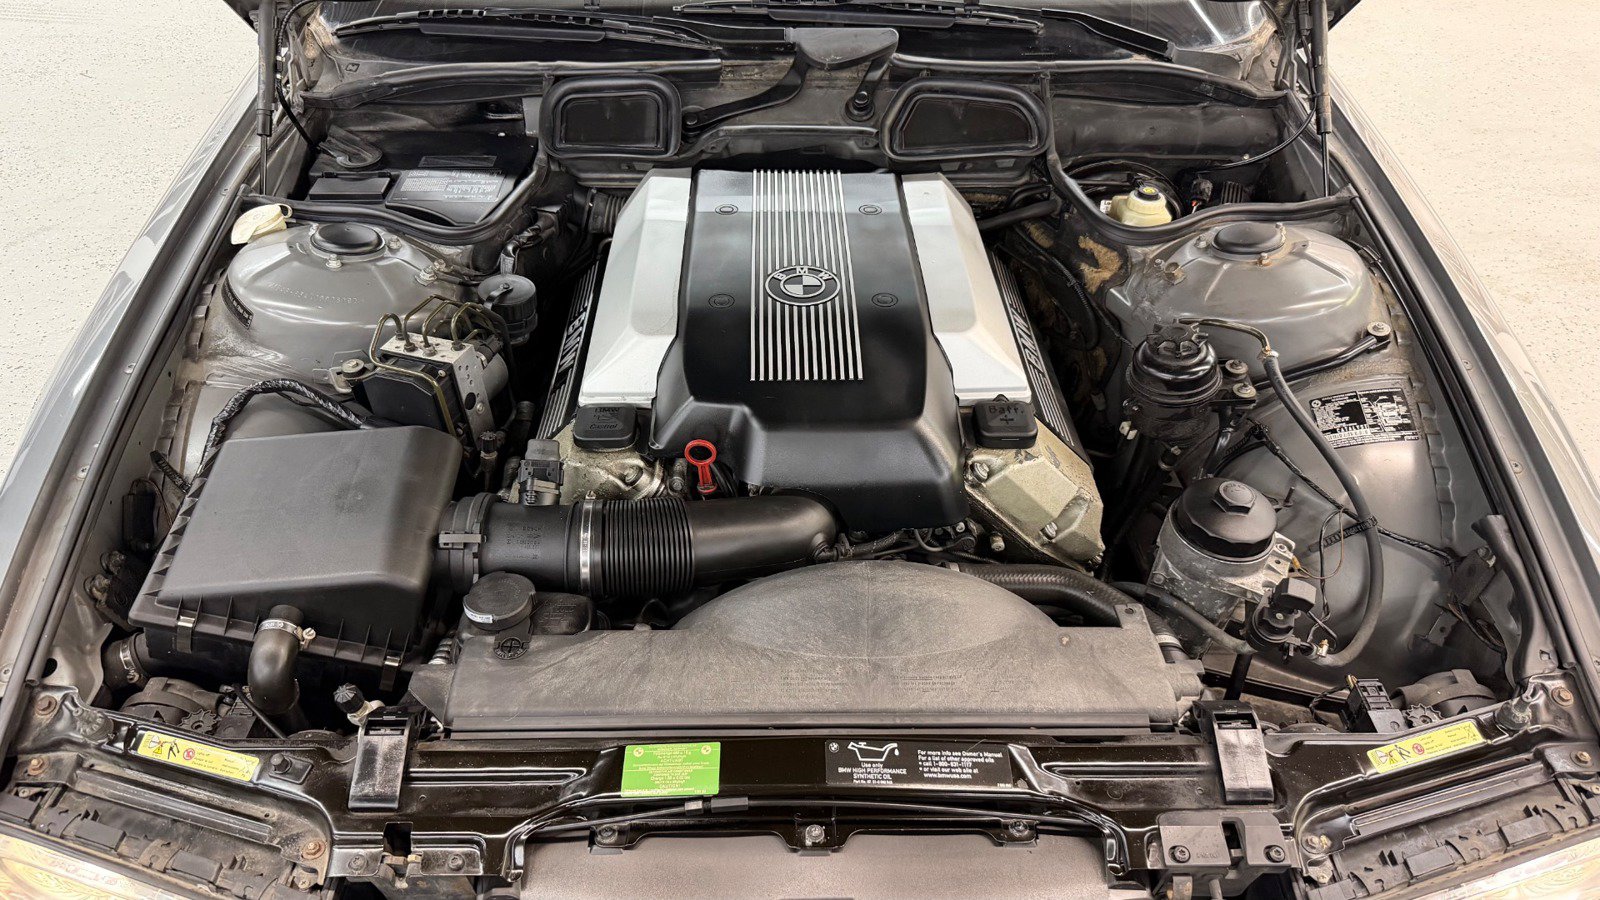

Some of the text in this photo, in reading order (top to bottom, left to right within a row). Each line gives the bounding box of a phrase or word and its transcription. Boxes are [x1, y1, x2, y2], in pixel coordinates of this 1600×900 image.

[773, 266, 834, 281] BMW
[558, 311, 586, 373] BMW
[1011, 307, 1044, 374] BMW
[866, 767, 907, 775] PERFORMANCE
